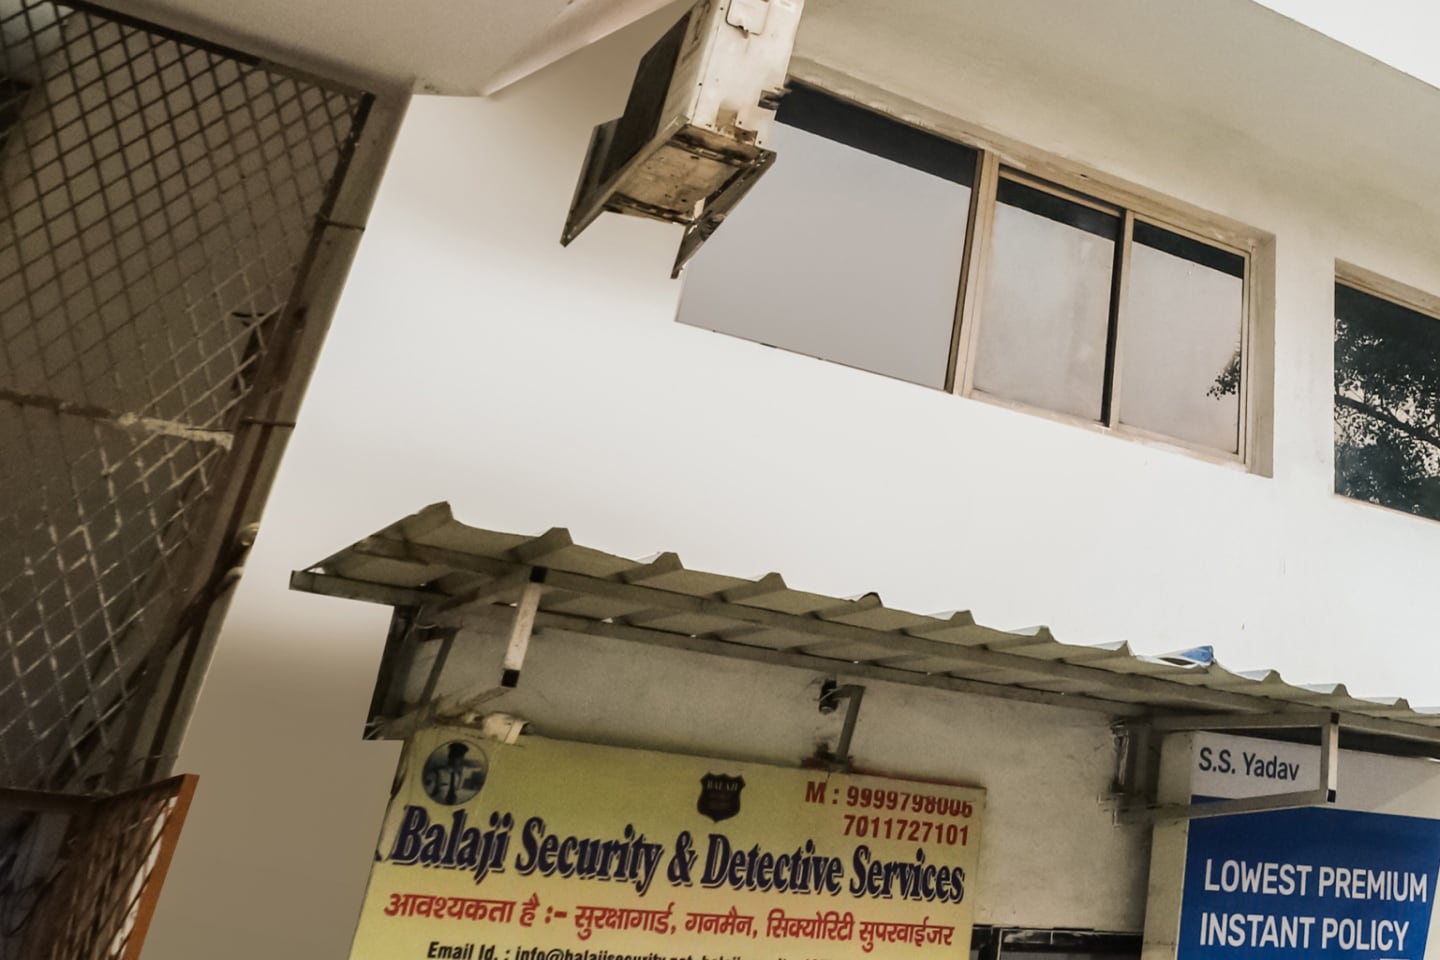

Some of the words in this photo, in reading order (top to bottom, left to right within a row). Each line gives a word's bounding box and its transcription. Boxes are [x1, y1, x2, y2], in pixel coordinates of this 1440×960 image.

[1199, 747, 1236, 774] S.S.
[1243, 752, 1300, 781] Yadav
[805, 781, 827, 804] M
[843, 814, 969, 846] 7011727101
[390, 804, 514, 885] Balaji
[515, 816, 663, 897] Security
[667, 830, 698, 887] &
[700, 834, 845, 896] Detective
[849, 844, 965, 903] Services
[1204, 859, 1312, 896] LOWEST
[1319, 866, 1428, 903] PREMIUM
[384, 892, 517, 924] आवश्यकता
[519, 892, 541, 928] है
[1200, 912, 1315, 949] INSTANT
[1321, 918, 1410, 951] POLICY
[427, 942, 474, 959] Email
